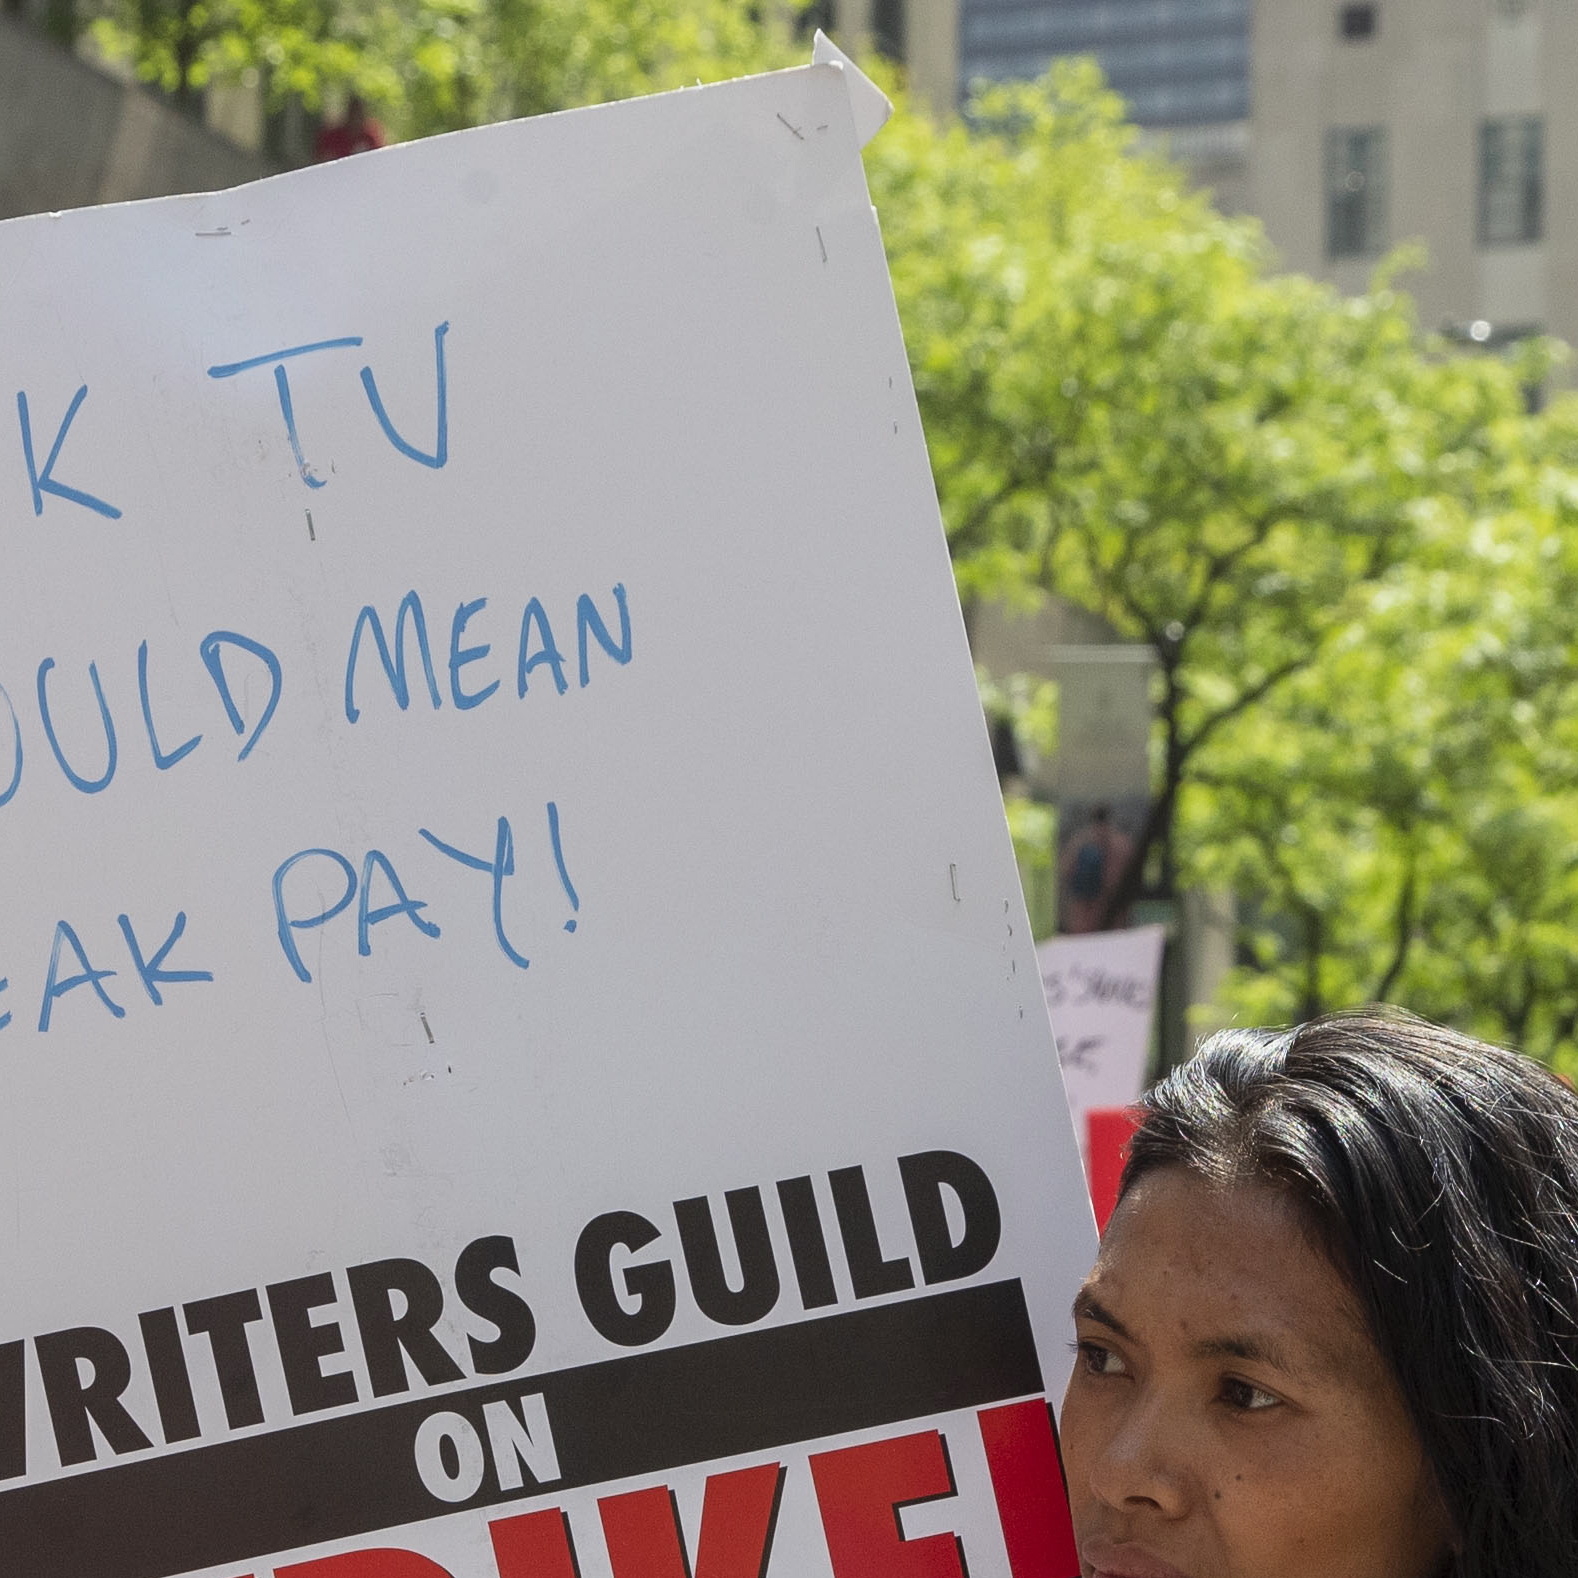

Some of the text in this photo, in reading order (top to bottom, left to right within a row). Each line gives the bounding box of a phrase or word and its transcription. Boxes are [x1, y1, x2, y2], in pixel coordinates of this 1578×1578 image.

[207, 319, 451, 489] TV
[343, 580, 633, 724] MEAN
[270, 800, 582, 984] PAY!
[573, 1149, 1003, 1349] GUILD
[413, 1392, 563, 1505] ON
